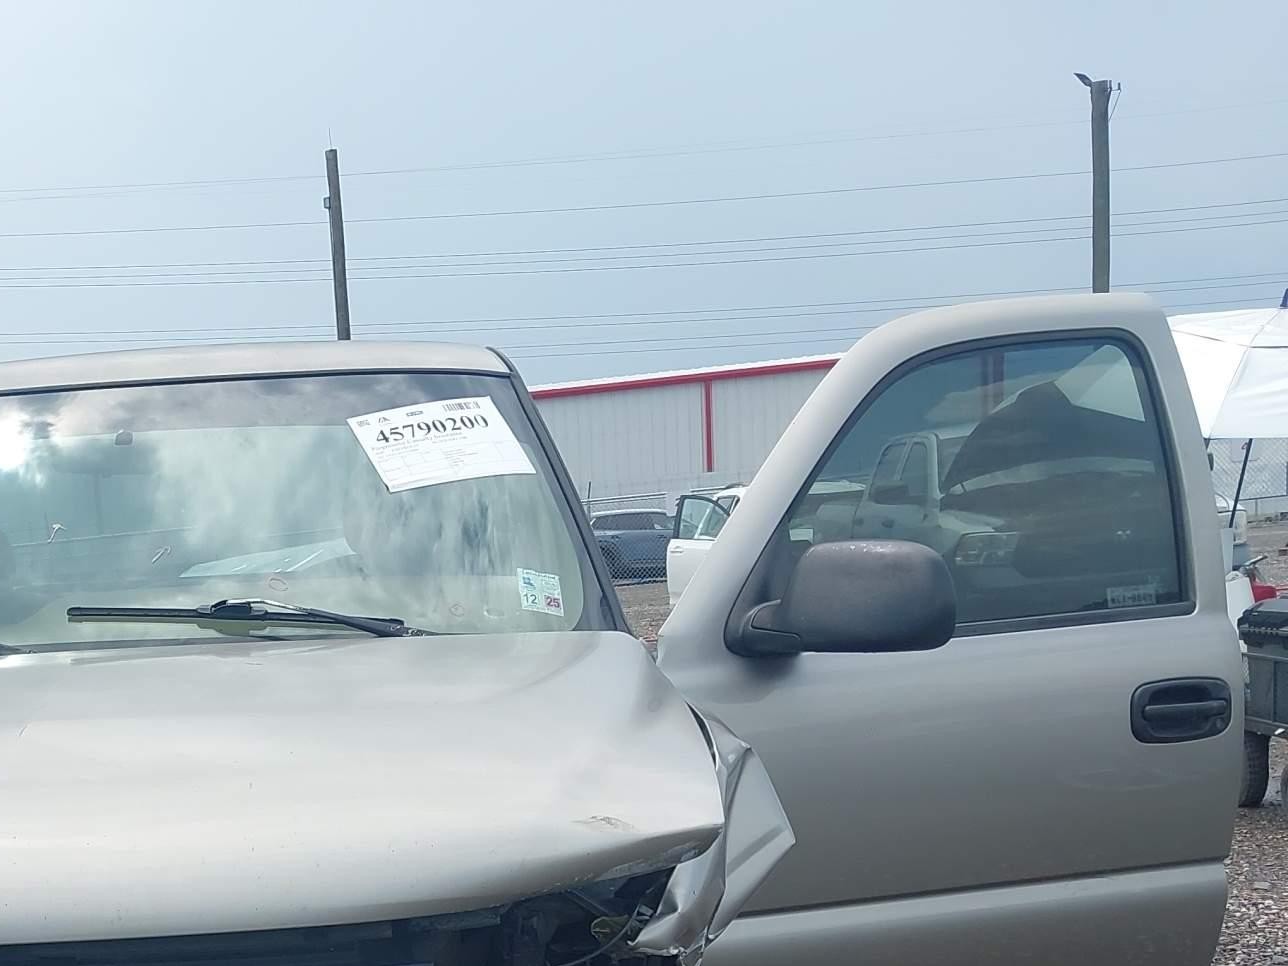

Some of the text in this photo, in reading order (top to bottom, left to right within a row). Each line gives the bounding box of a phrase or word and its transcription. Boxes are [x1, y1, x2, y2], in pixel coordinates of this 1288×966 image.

[376, 413, 489, 443] 45790200
[523, 593, 538, 605] 12
[546, 596, 560, 608] 25
